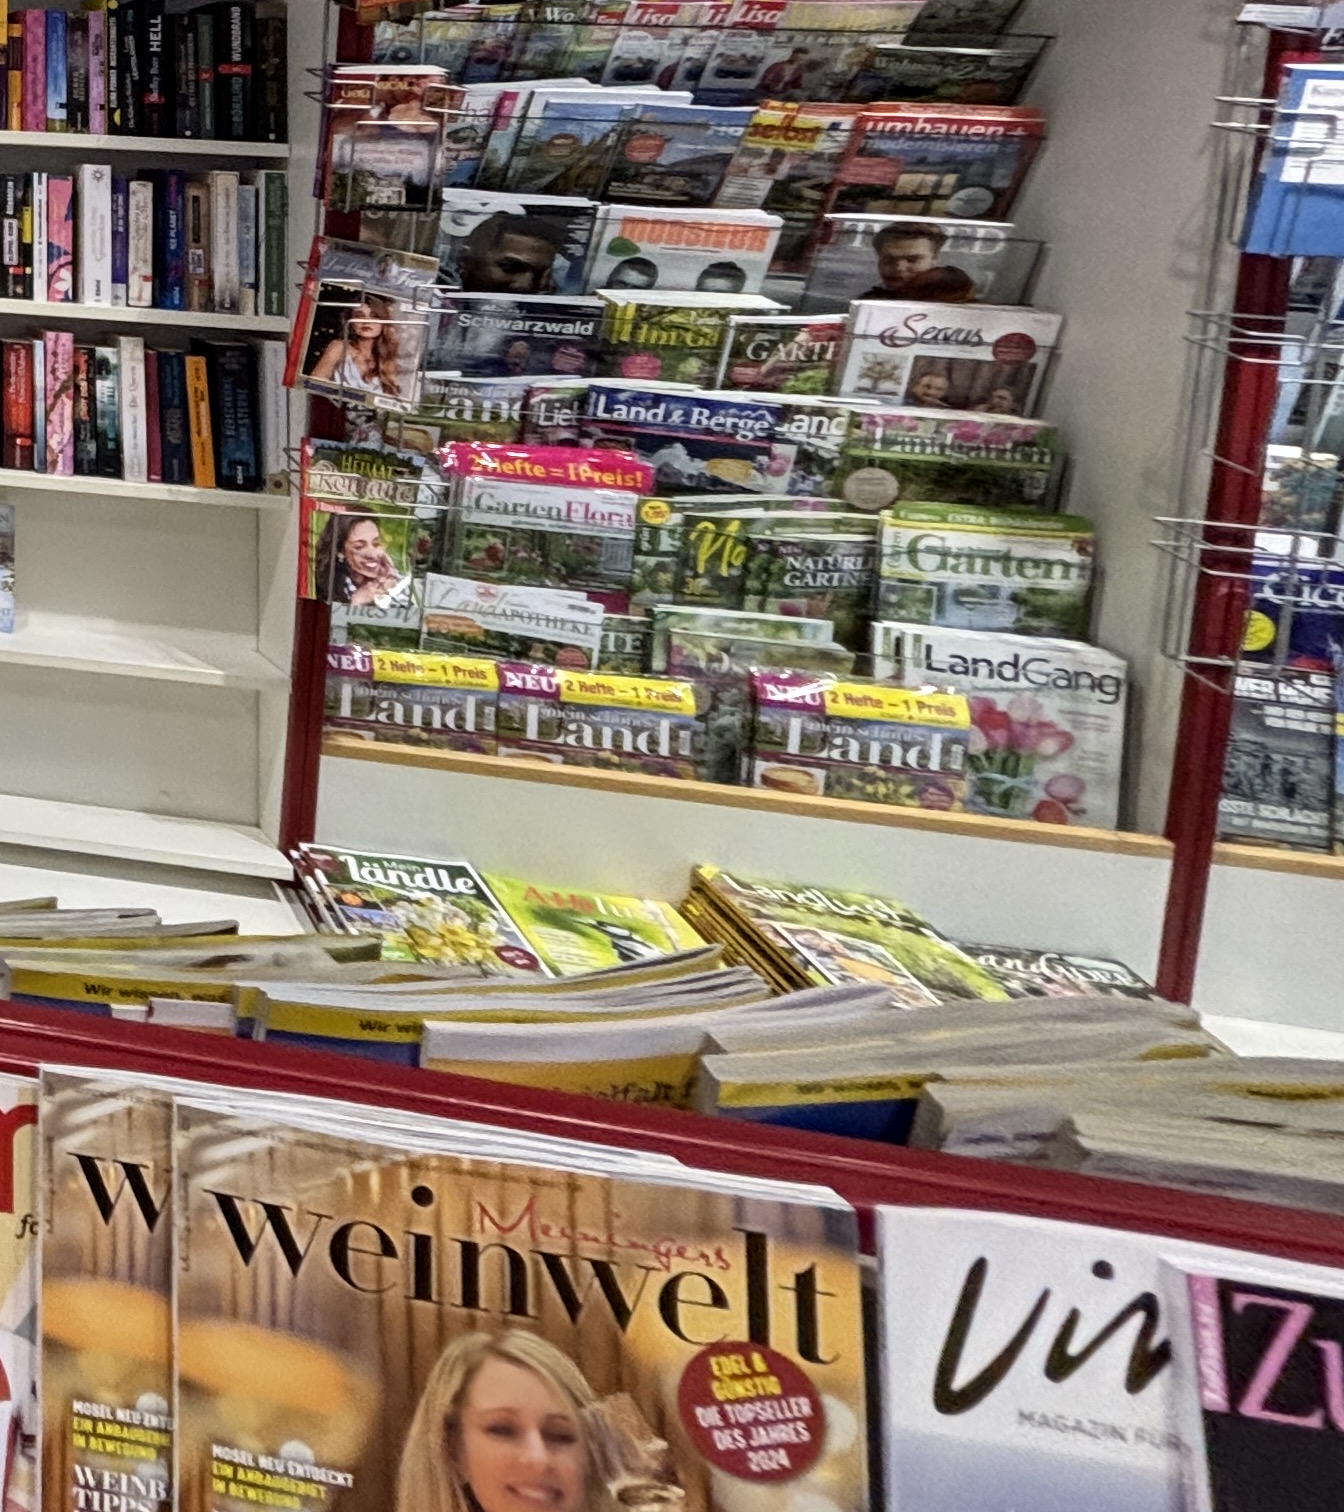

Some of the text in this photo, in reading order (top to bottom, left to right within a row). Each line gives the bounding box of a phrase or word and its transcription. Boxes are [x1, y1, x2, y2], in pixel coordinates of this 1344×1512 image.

[150, 15, 163, 52] HELL
[458, 314, 594, 337] Schwarzwald
[597, 397, 666, 423] Land
[925, 643, 1123, 704] LandGang
[786, 717, 943, 772] Land
[202, 1184, 839, 1367] weinwelt
[726, 1397, 812, 1426] TOPSELLER
[715, 1421, 812, 1452] DES JAHRES
[748, 1449, 792, 1474] 2024
